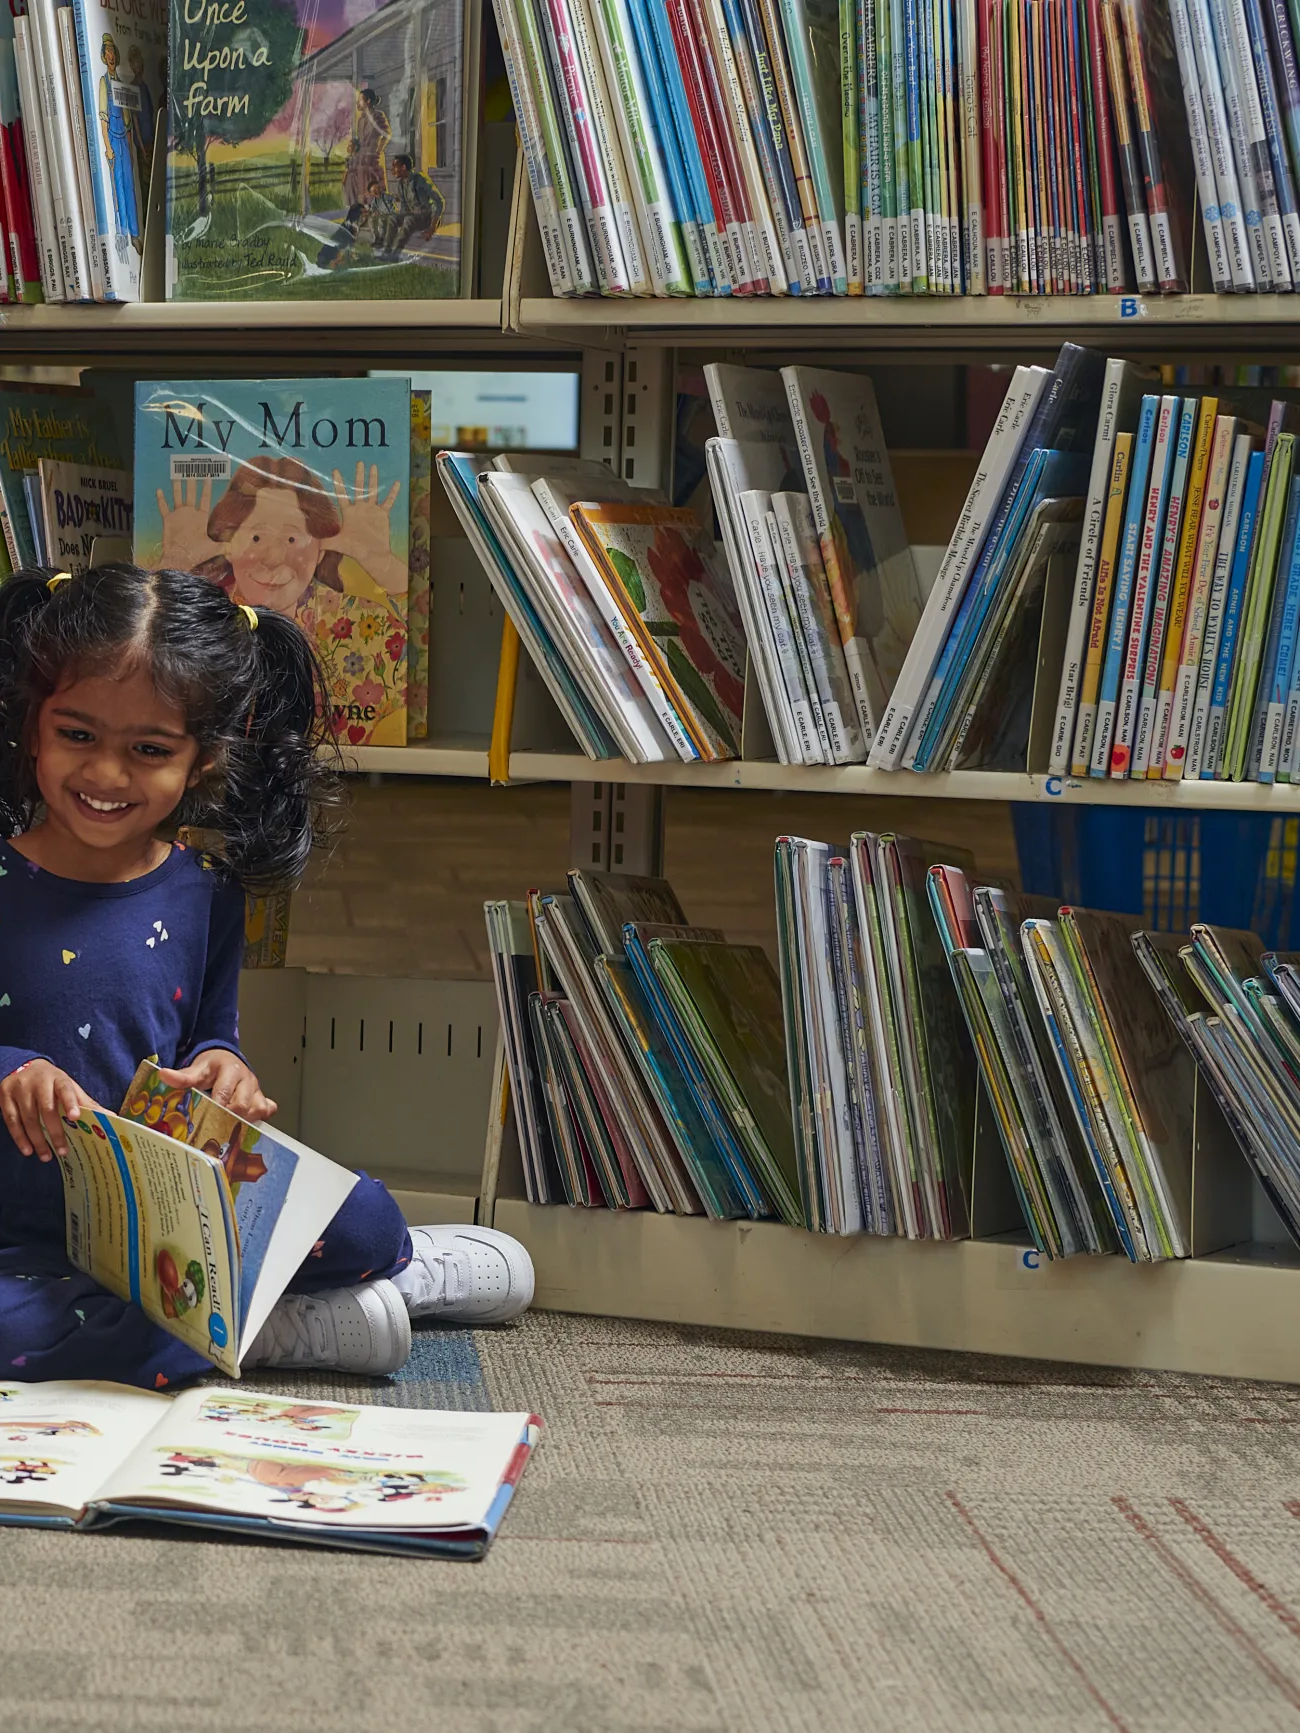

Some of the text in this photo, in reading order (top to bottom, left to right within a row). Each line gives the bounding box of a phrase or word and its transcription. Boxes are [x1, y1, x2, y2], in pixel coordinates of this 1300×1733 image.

[184, 0, 247, 25] Once
[183, 39, 272, 81] Upon a
[1276, 3, 1298, 89] CRICKWING
[565, 65, 577, 102] Picnic
[757, 52, 783, 150] Just Like My Papa
[1121, 298, 1138, 318] B
[161, 401, 390, 452] My Mom
[81, 477, 118, 492] NICK BRUEL
[1079, 382, 1117, 607] Giora Carmi A Circle of Friends
[54, 489, 134, 531] BAD KITT
[940, 471, 987, 580] The Secret Birthday Message
[58, 537, 80, 556] Does
[1145, 412, 1191, 687] CARLSON HENRY'S AMAZING IMAGINATION!
[1216, 552, 1229, 572] THE
[560, 526, 643, 670] Eric Carle You Are Ready!
[1126, 487, 1159, 680] HENRY AND THE VALENTINE SURPRIS
[1213, 574, 1225, 597] WAY
[1210, 600, 1219, 615] TO
[1215, 512, 1251, 702] CARLSON ARNIE AND THE NEW KID
[1199, 659, 1213, 691] HOUSE
[1045, 777, 1063, 797] C
[201, 1211, 220, 1311] I Can Read!
[1022, 1250, 1040, 1269] C
